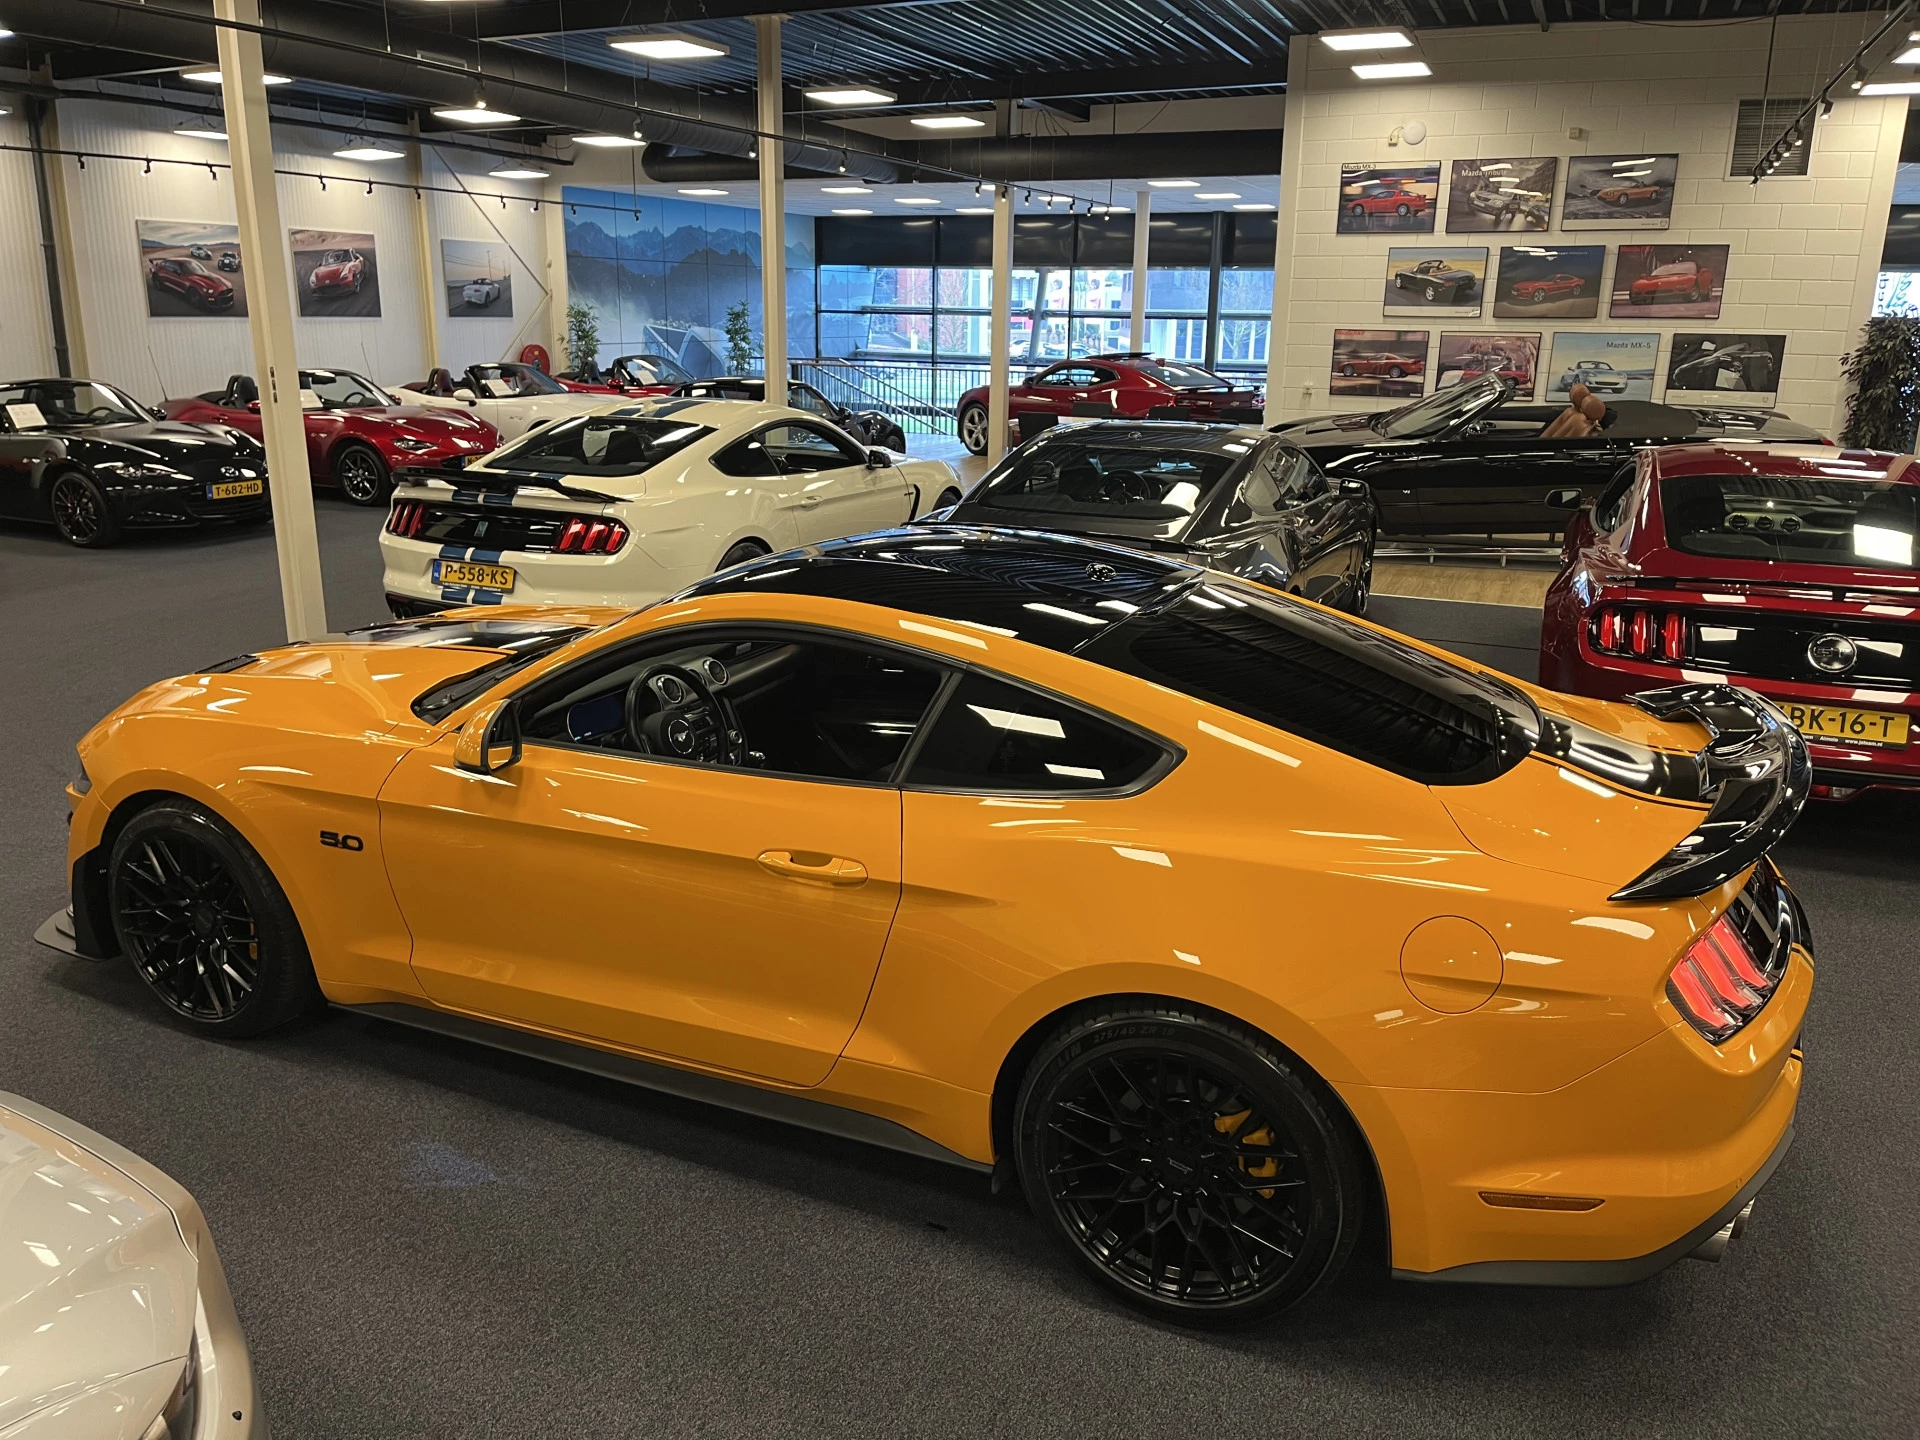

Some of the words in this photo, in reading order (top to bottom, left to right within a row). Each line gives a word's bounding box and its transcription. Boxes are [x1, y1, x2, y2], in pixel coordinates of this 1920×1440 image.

[1461, 169, 1482, 177] Mazda
[1606, 341, 1629, 349] Mazda
[1630, 341, 1652, 349] MX-5
[214, 482, 260, 497] T-682-HD
[444, 563, 509, 586] P-558-KS
[1779, 705, 1895, 738] BK-16-T
[320, 830, 364, 851] 5.0
